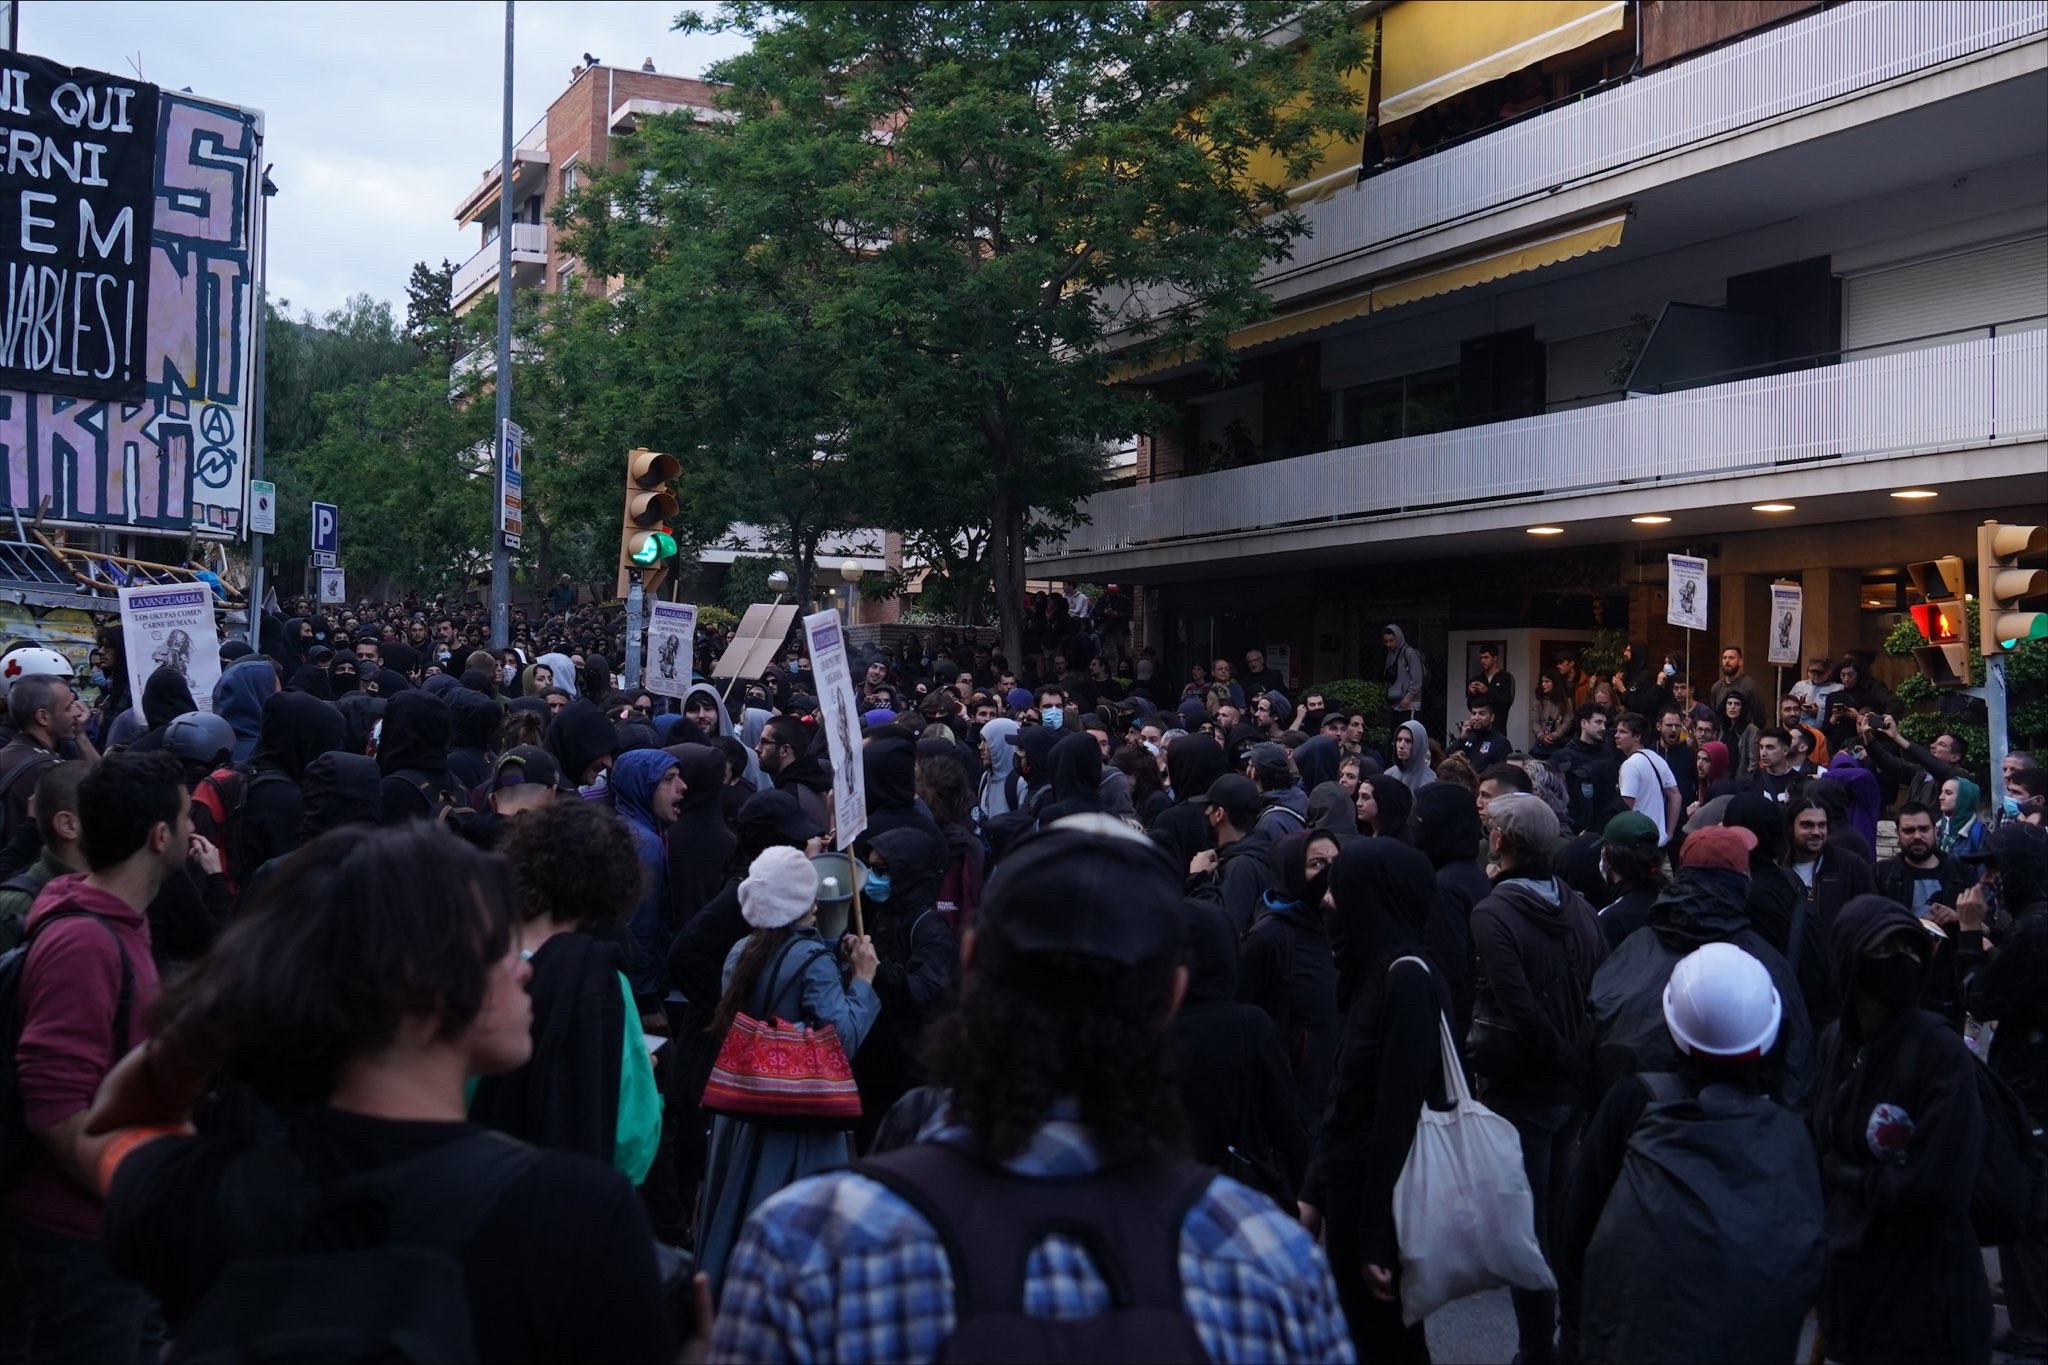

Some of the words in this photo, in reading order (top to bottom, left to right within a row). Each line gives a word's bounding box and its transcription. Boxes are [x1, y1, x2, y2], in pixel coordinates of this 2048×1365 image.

[50, 82, 136, 134] QUI
[318, 508, 333, 546] P
[134, 613, 149, 622] LOS
[150, 611, 177, 621] OKUPAS
[177, 608, 202, 618] COMEN
[142, 621, 166, 630] CARNE
[167, 618, 198, 628] HUMANA
